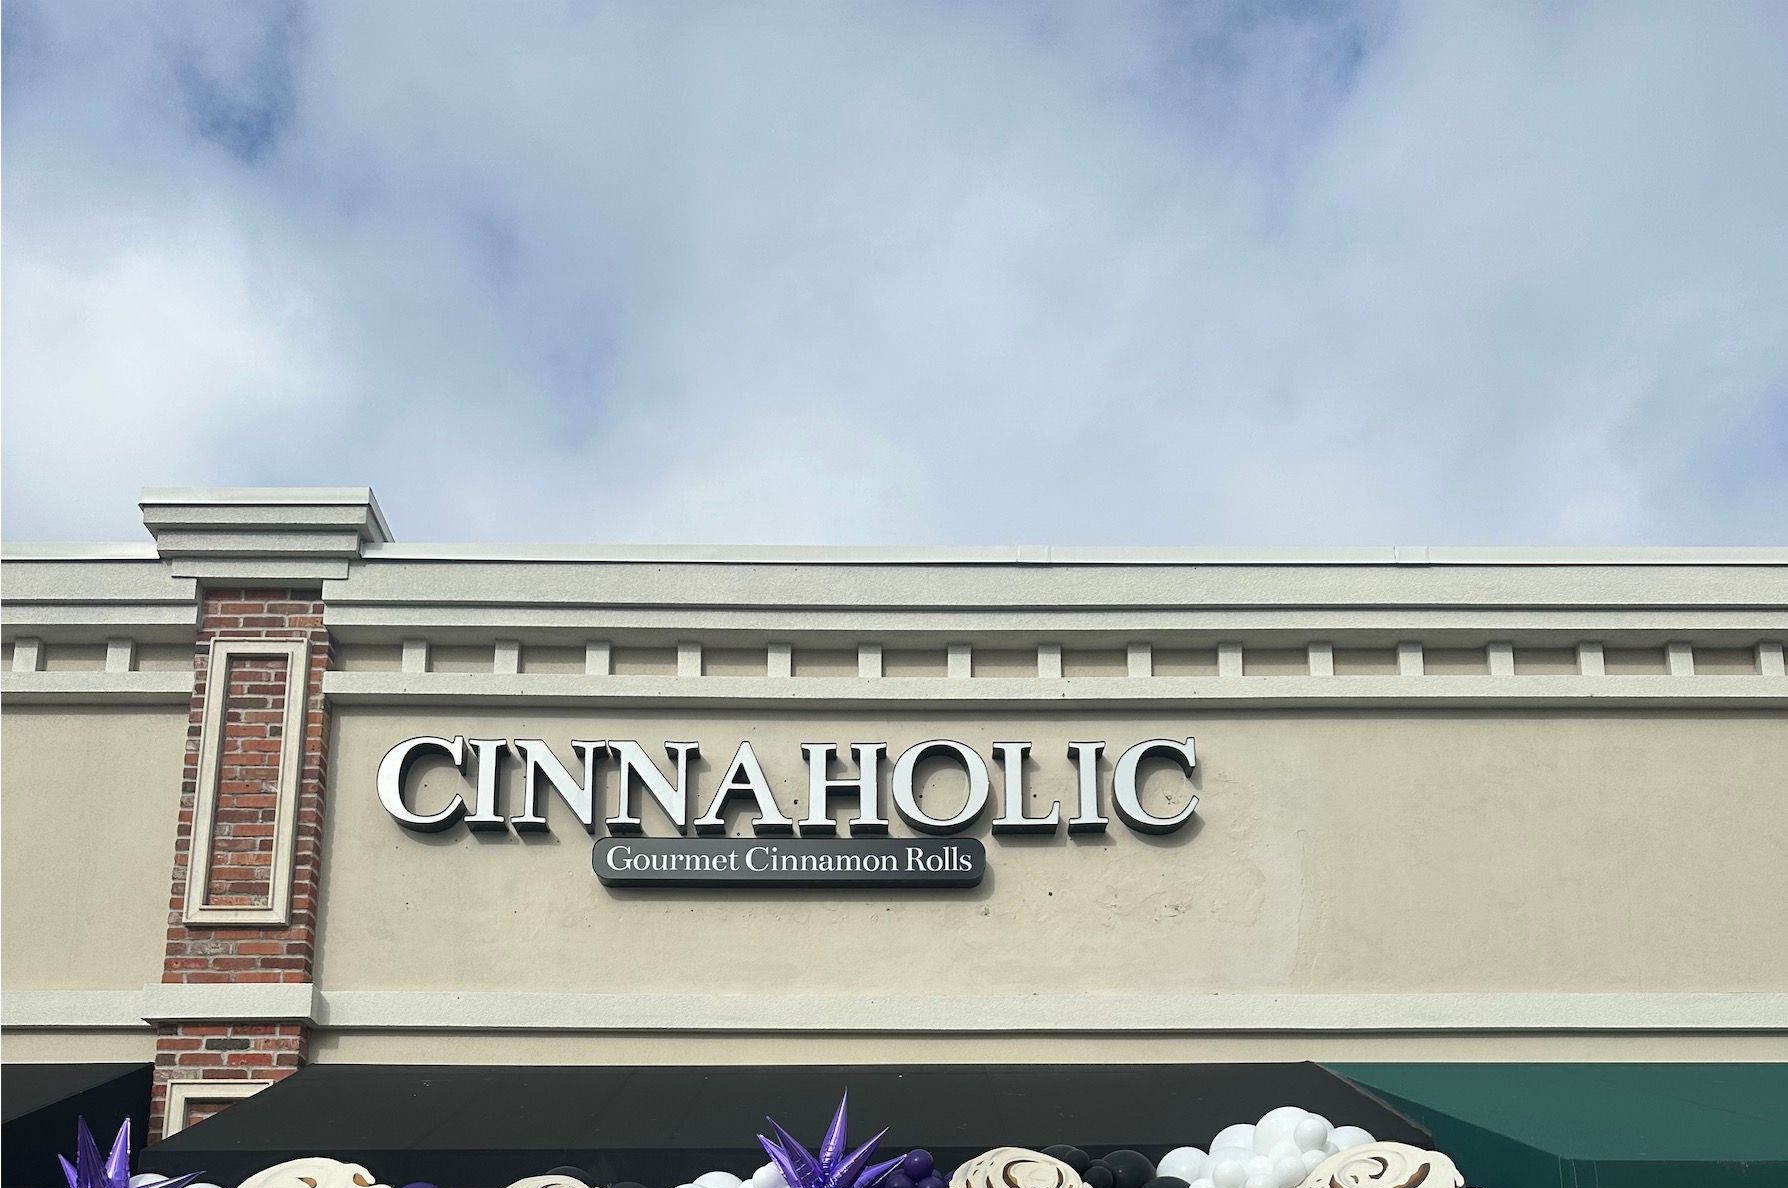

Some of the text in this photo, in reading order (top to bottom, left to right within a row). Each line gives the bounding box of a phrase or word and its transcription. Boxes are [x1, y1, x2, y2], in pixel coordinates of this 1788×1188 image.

[376, 736, 1200, 833] CINNAHOLIC
[606, 845, 973, 873] Gourmet Cinnamon Rolls
